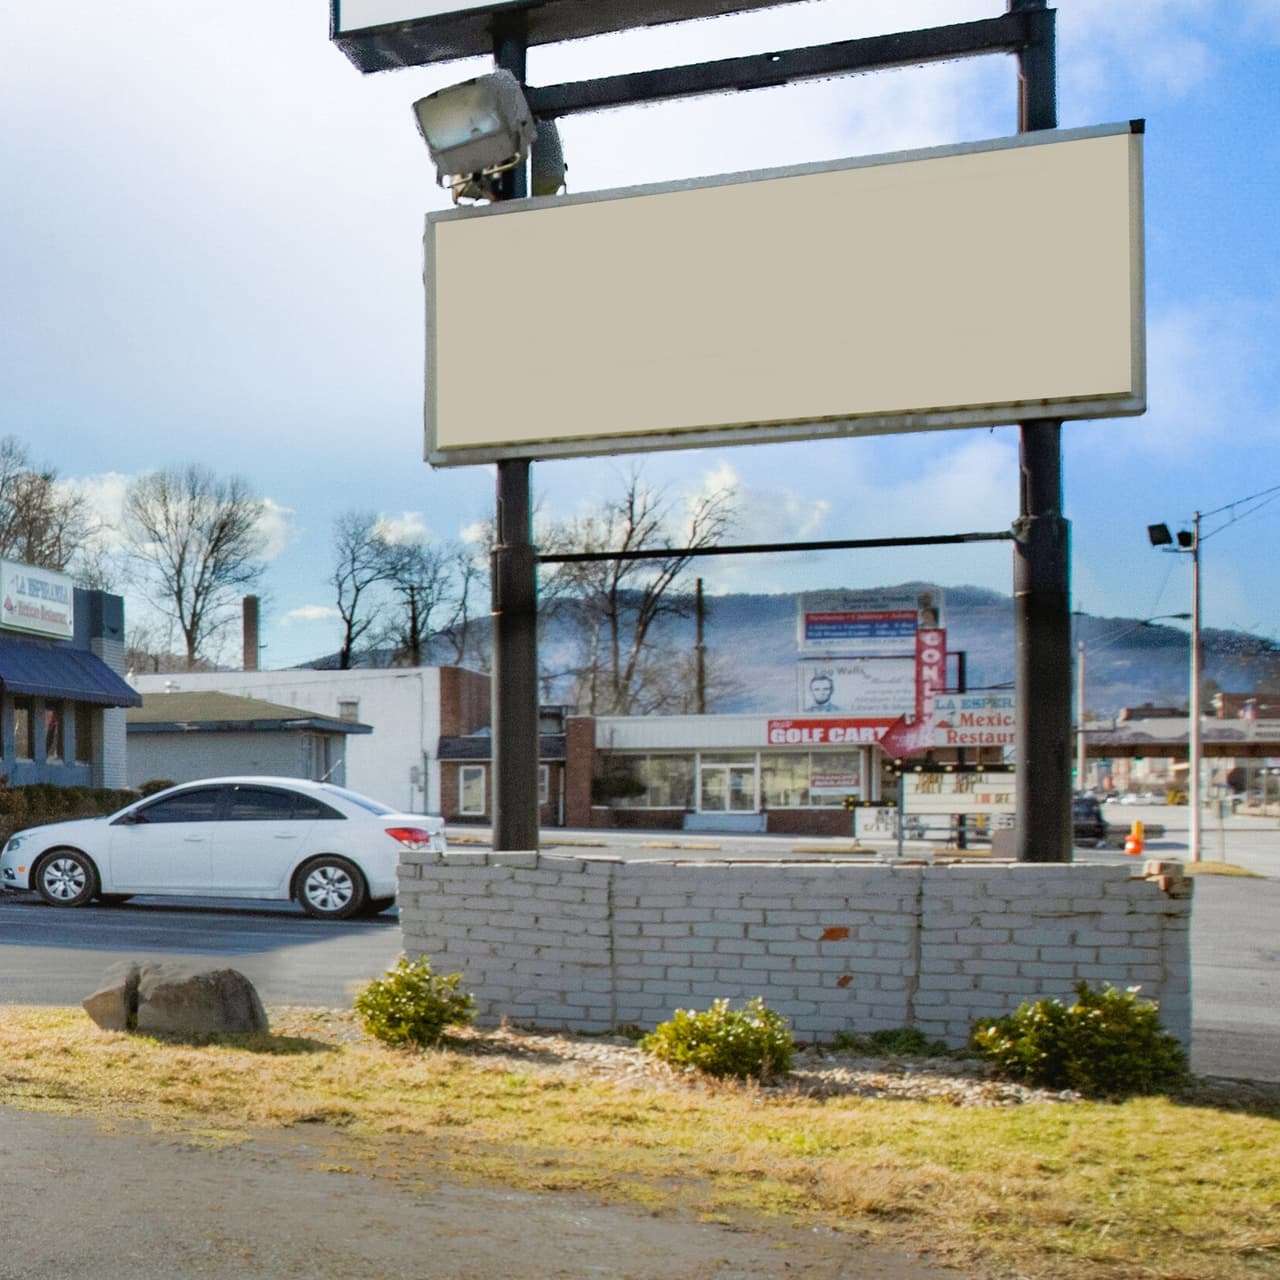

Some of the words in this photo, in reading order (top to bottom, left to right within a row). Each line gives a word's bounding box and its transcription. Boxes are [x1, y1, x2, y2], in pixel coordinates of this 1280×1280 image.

[961, 697, 1015, 709] ESPER
[960, 712, 1016, 727] Mexic
[770, 727, 825, 743] GOLF
[946, 729, 1016, 744] Restaur
